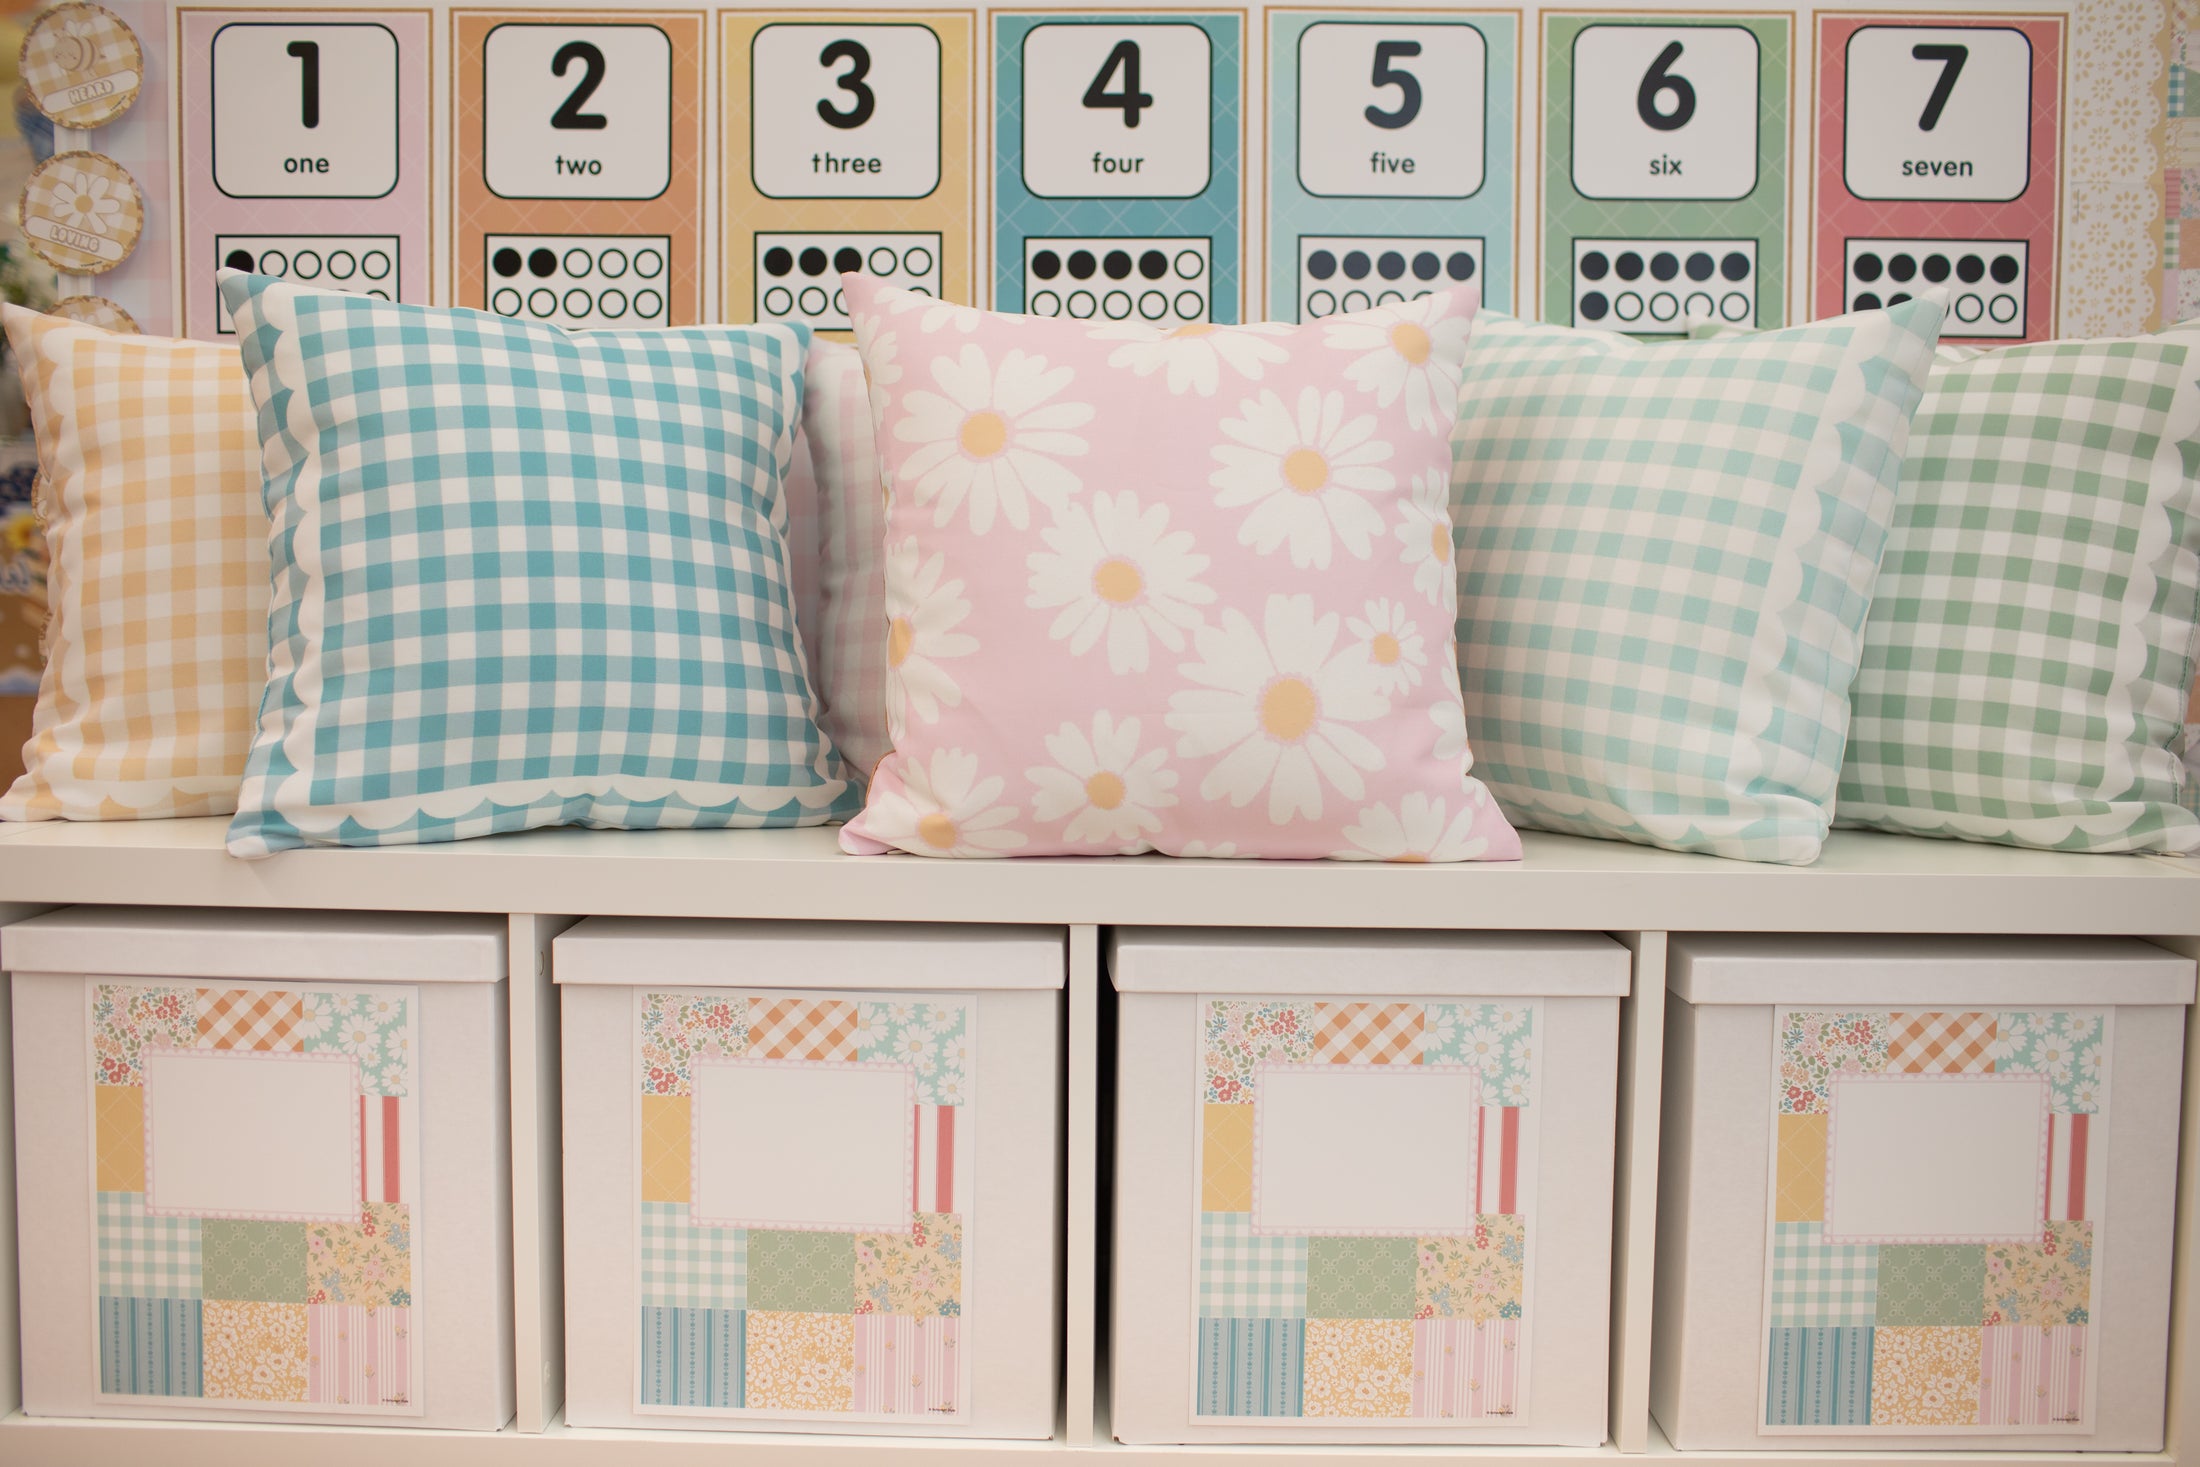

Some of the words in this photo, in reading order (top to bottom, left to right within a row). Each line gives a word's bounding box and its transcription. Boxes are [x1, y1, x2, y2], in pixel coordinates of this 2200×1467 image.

[68, 79, 114, 105] HEARD
[286, 40, 320, 130] 1
[550, 40, 608, 131] 2
[816, 39, 876, 130] 3
[1081, 40, 1153, 129] 4
[1364, 40, 1422, 130] 5
[1636, 40, 1697, 132] 6
[1911, 44, 1969, 132] 7
[283, 156, 330, 175] one
[555, 155, 602, 176] two
[812, 152, 882, 174] three
[1092, 151, 1144, 174] four
[1370, 152, 1415, 174] five
[1649, 154, 1682, 176] six
[1901, 160, 1973, 177] seven
[50, 226, 99, 253] LOVING
